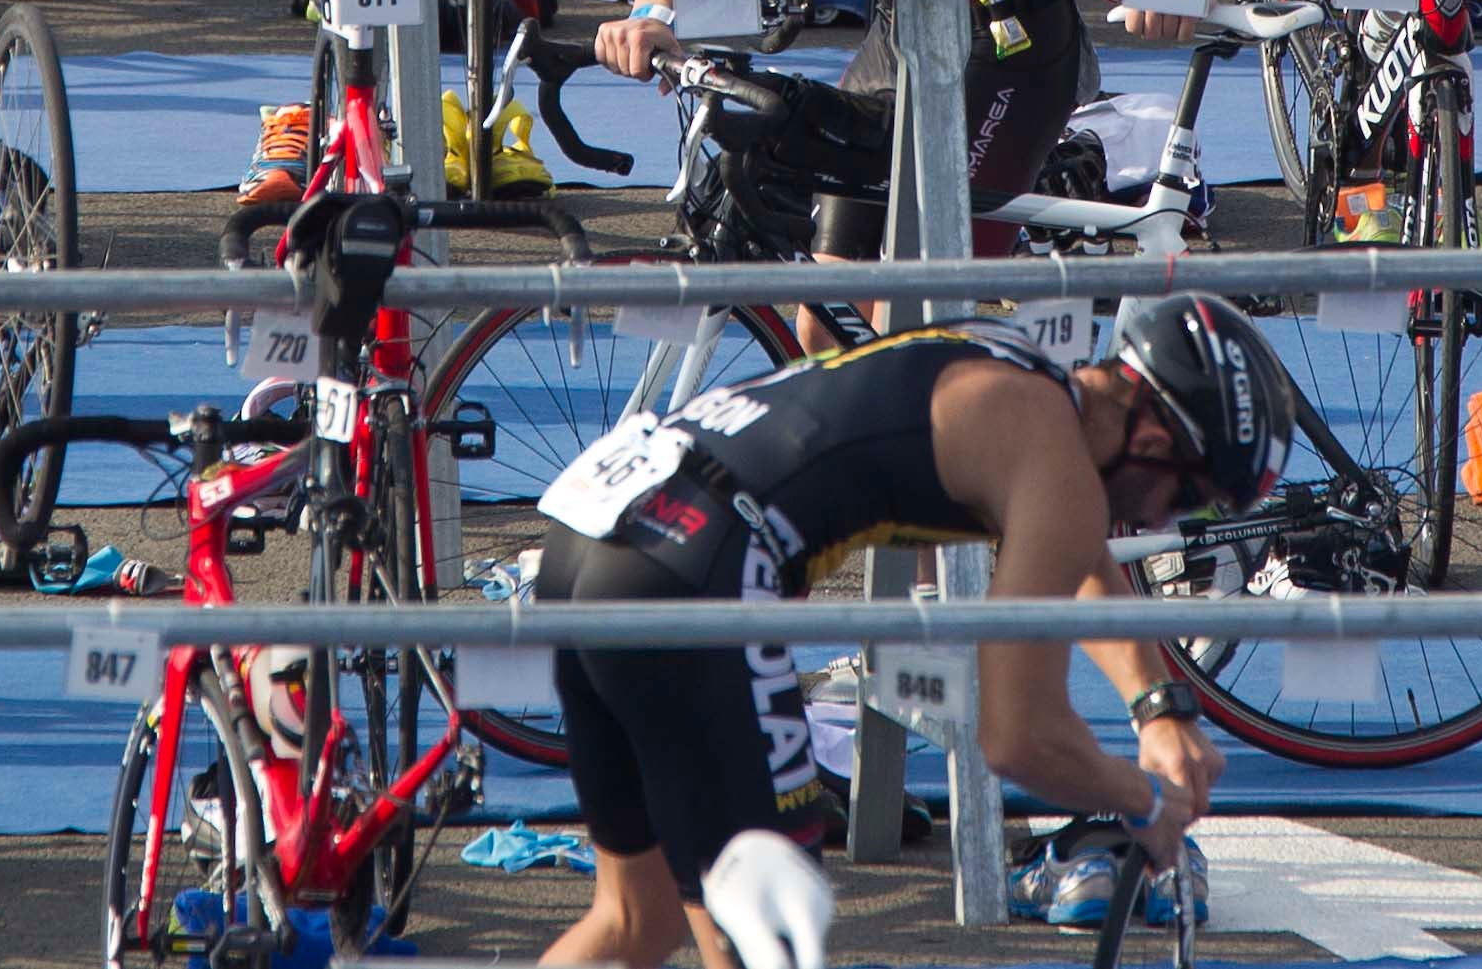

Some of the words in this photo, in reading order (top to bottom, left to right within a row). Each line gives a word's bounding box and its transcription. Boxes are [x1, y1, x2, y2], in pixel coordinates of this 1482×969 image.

[966, 87, 1016, 179] MAREA
[1033, 313, 1073, 346] 719
[265, 333, 308, 365] 720
[1233, 372, 1255, 444] GIRO
[199, 480, 234, 508] S3
[1217, 523, 1279, 544] COLUMBUS
[85, 649, 136, 687] 847
[896, 671, 946, 705] 846
